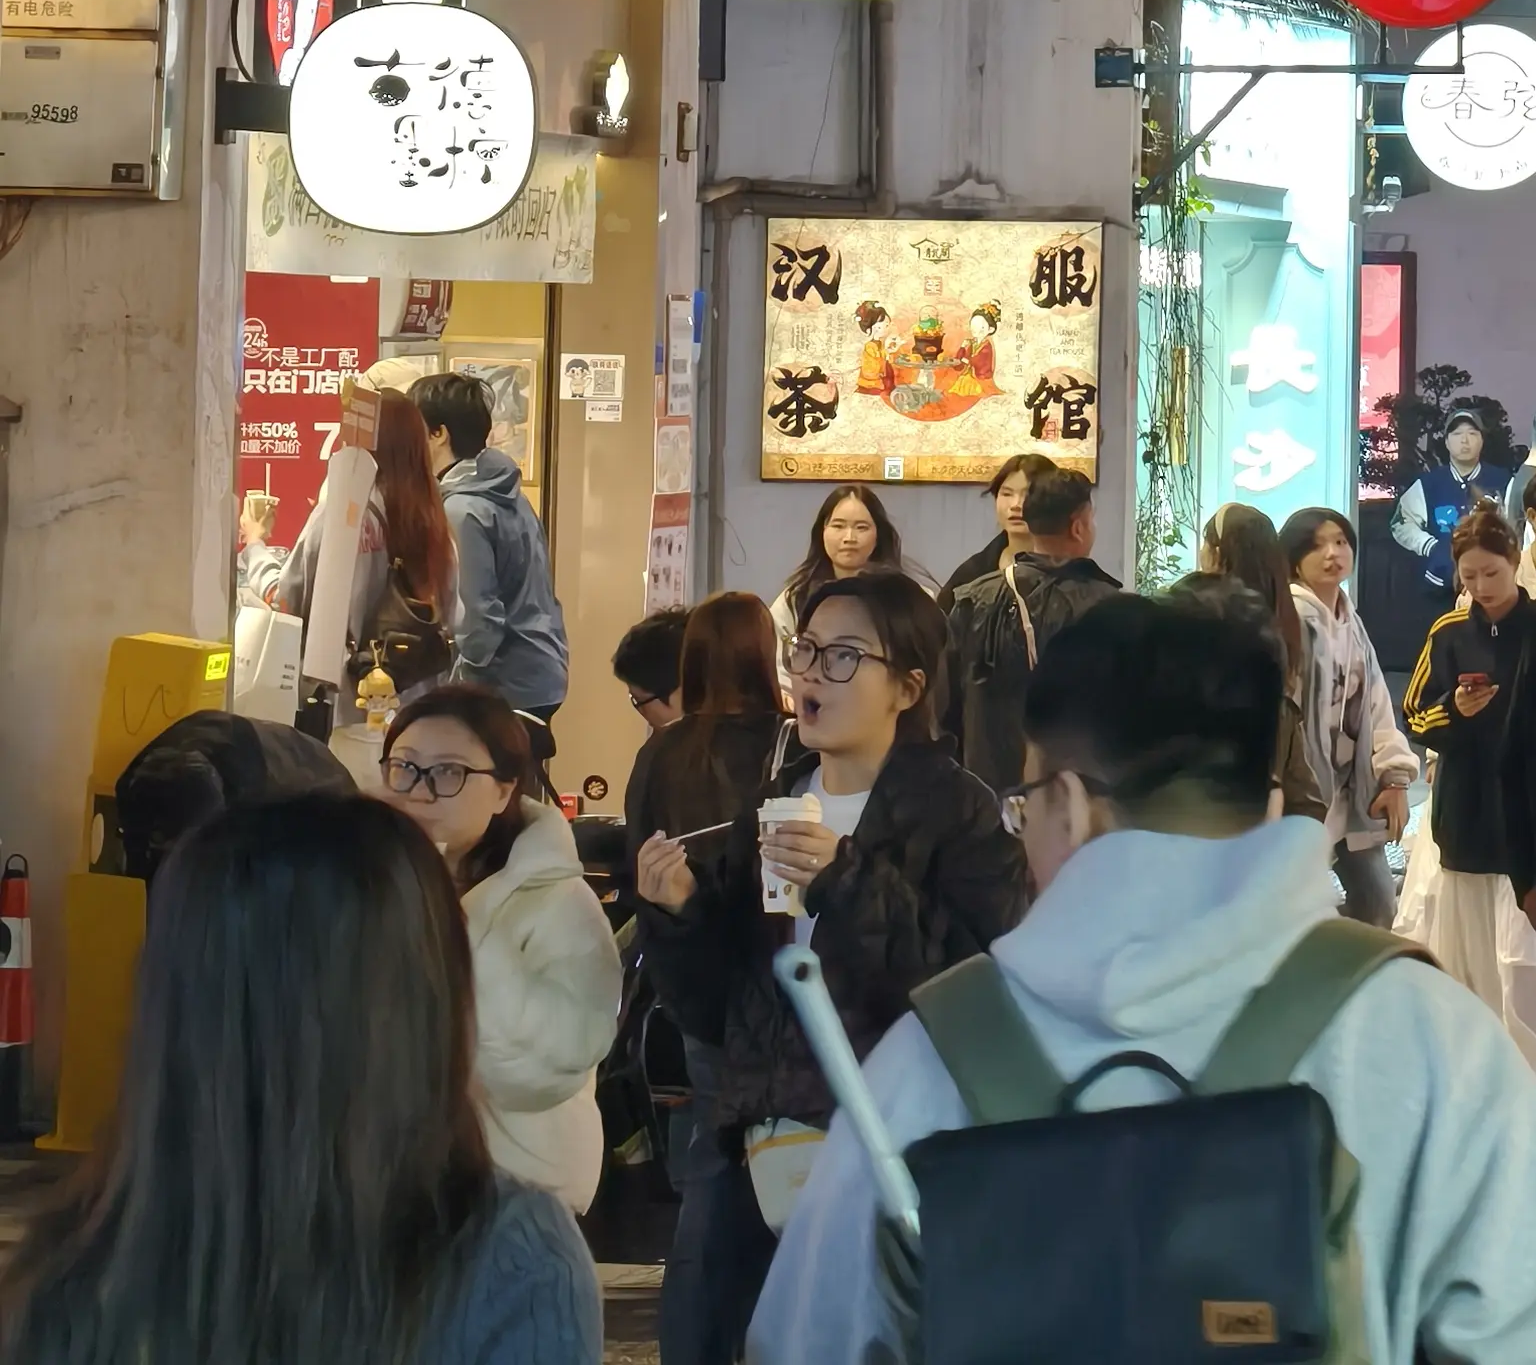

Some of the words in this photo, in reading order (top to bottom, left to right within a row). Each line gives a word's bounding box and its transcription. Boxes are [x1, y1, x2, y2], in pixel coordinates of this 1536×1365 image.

[5, 0, 75, 17] 有电危险
[31, 103, 79, 122] 95598
[770, 241, 842, 305] 汉
[1028, 243, 1097, 309] 服
[260, 347, 359, 367] 不是工厂配
[767, 365, 838, 437] 茶
[1023, 374, 1097, 442] 馆
